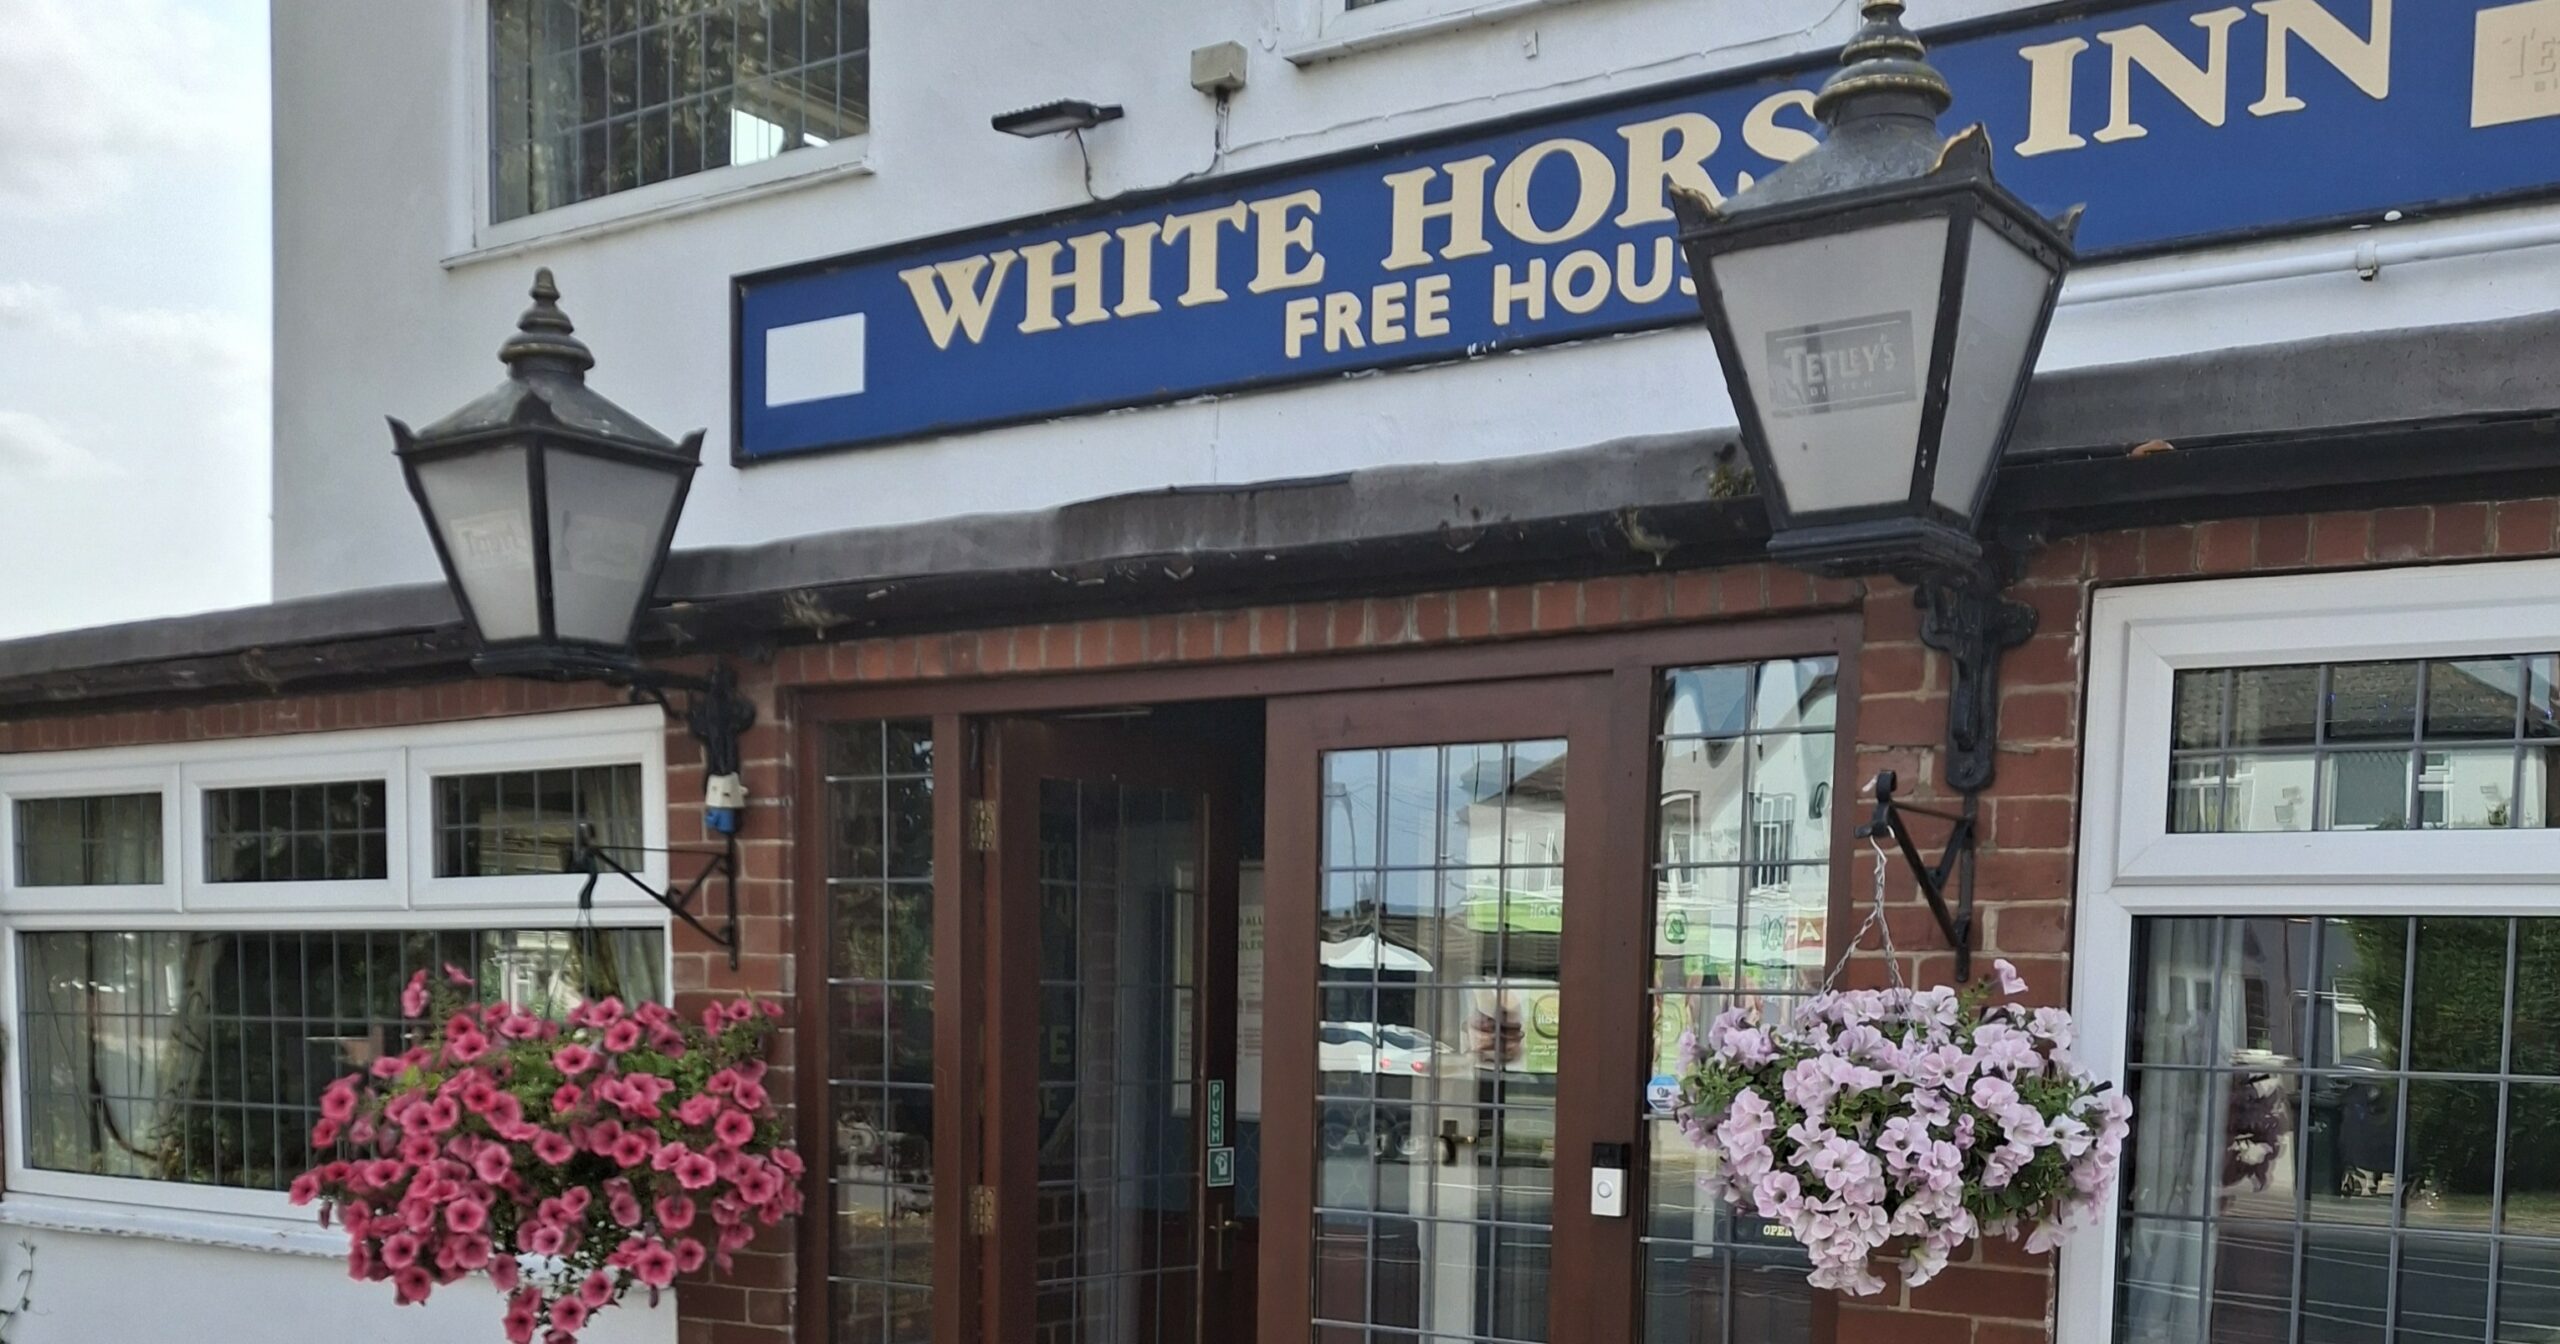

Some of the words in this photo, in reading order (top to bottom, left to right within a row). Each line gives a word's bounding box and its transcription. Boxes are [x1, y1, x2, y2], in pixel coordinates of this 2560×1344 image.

[901, 191, 1323, 347] WHITE
[1383, 89, 1823, 270] HORS
[2016, 0, 2391, 156] INN
[1285, 274, 1450, 358] FREE
[1783, 333, 1897, 385] TETLEY'S
[1211, 1084, 1220, 1142] PUSH
